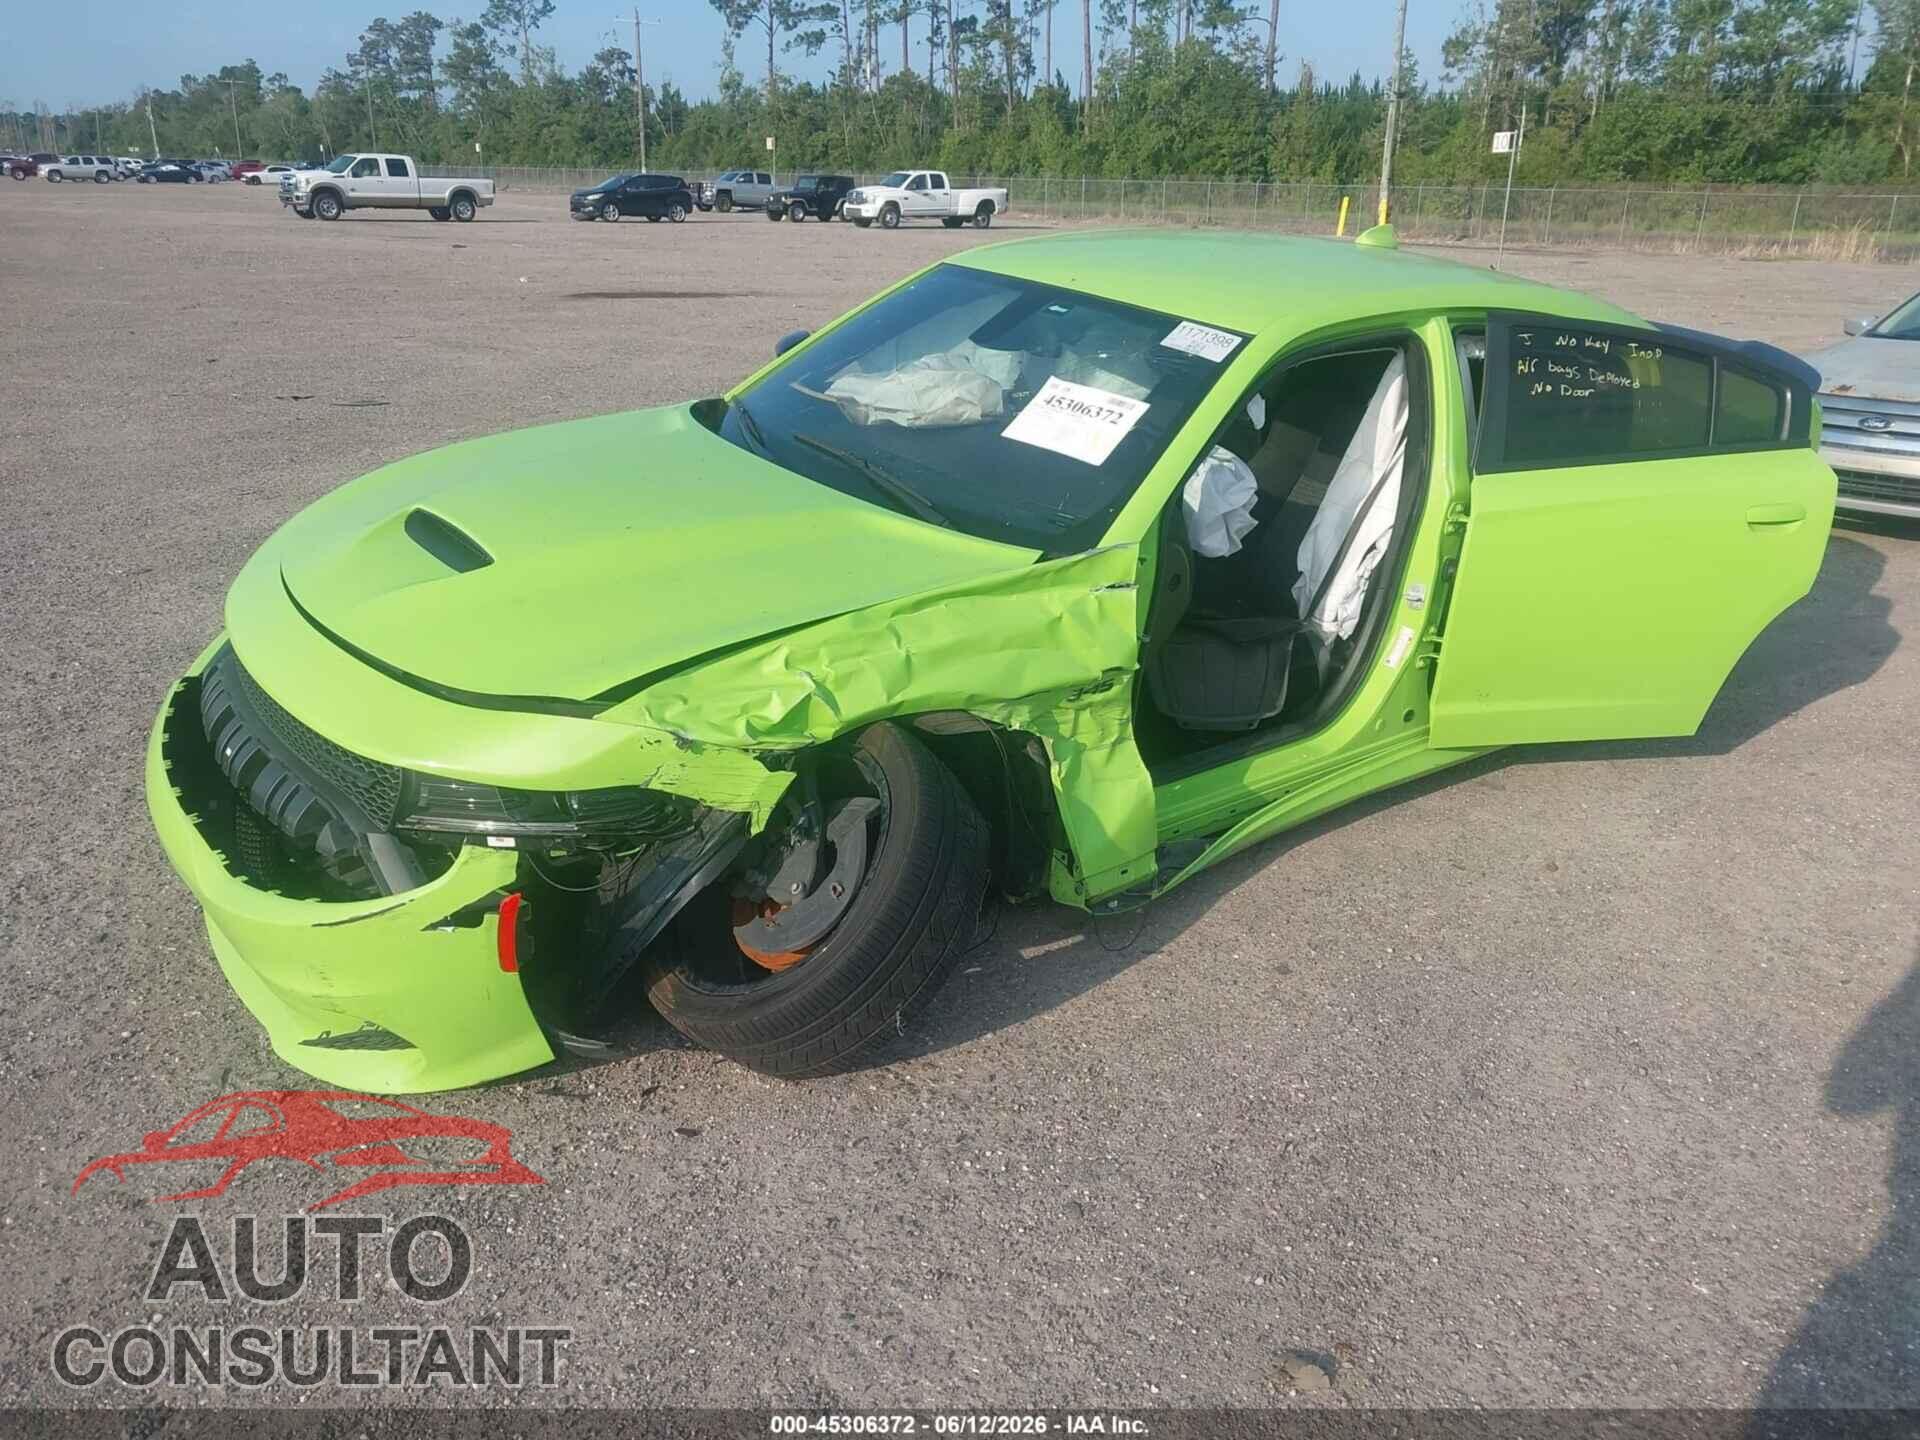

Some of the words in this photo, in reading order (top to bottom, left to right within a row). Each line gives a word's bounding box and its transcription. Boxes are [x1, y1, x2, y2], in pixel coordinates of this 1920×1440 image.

[1555, 334, 1577, 347] No
[1548, 359, 1581, 380] bags
[1530, 381, 1553, 395] No
[1560, 384, 1596, 397] Door
[1043, 394, 1124, 425] 45306372
[1065, 678, 1114, 703] 345
